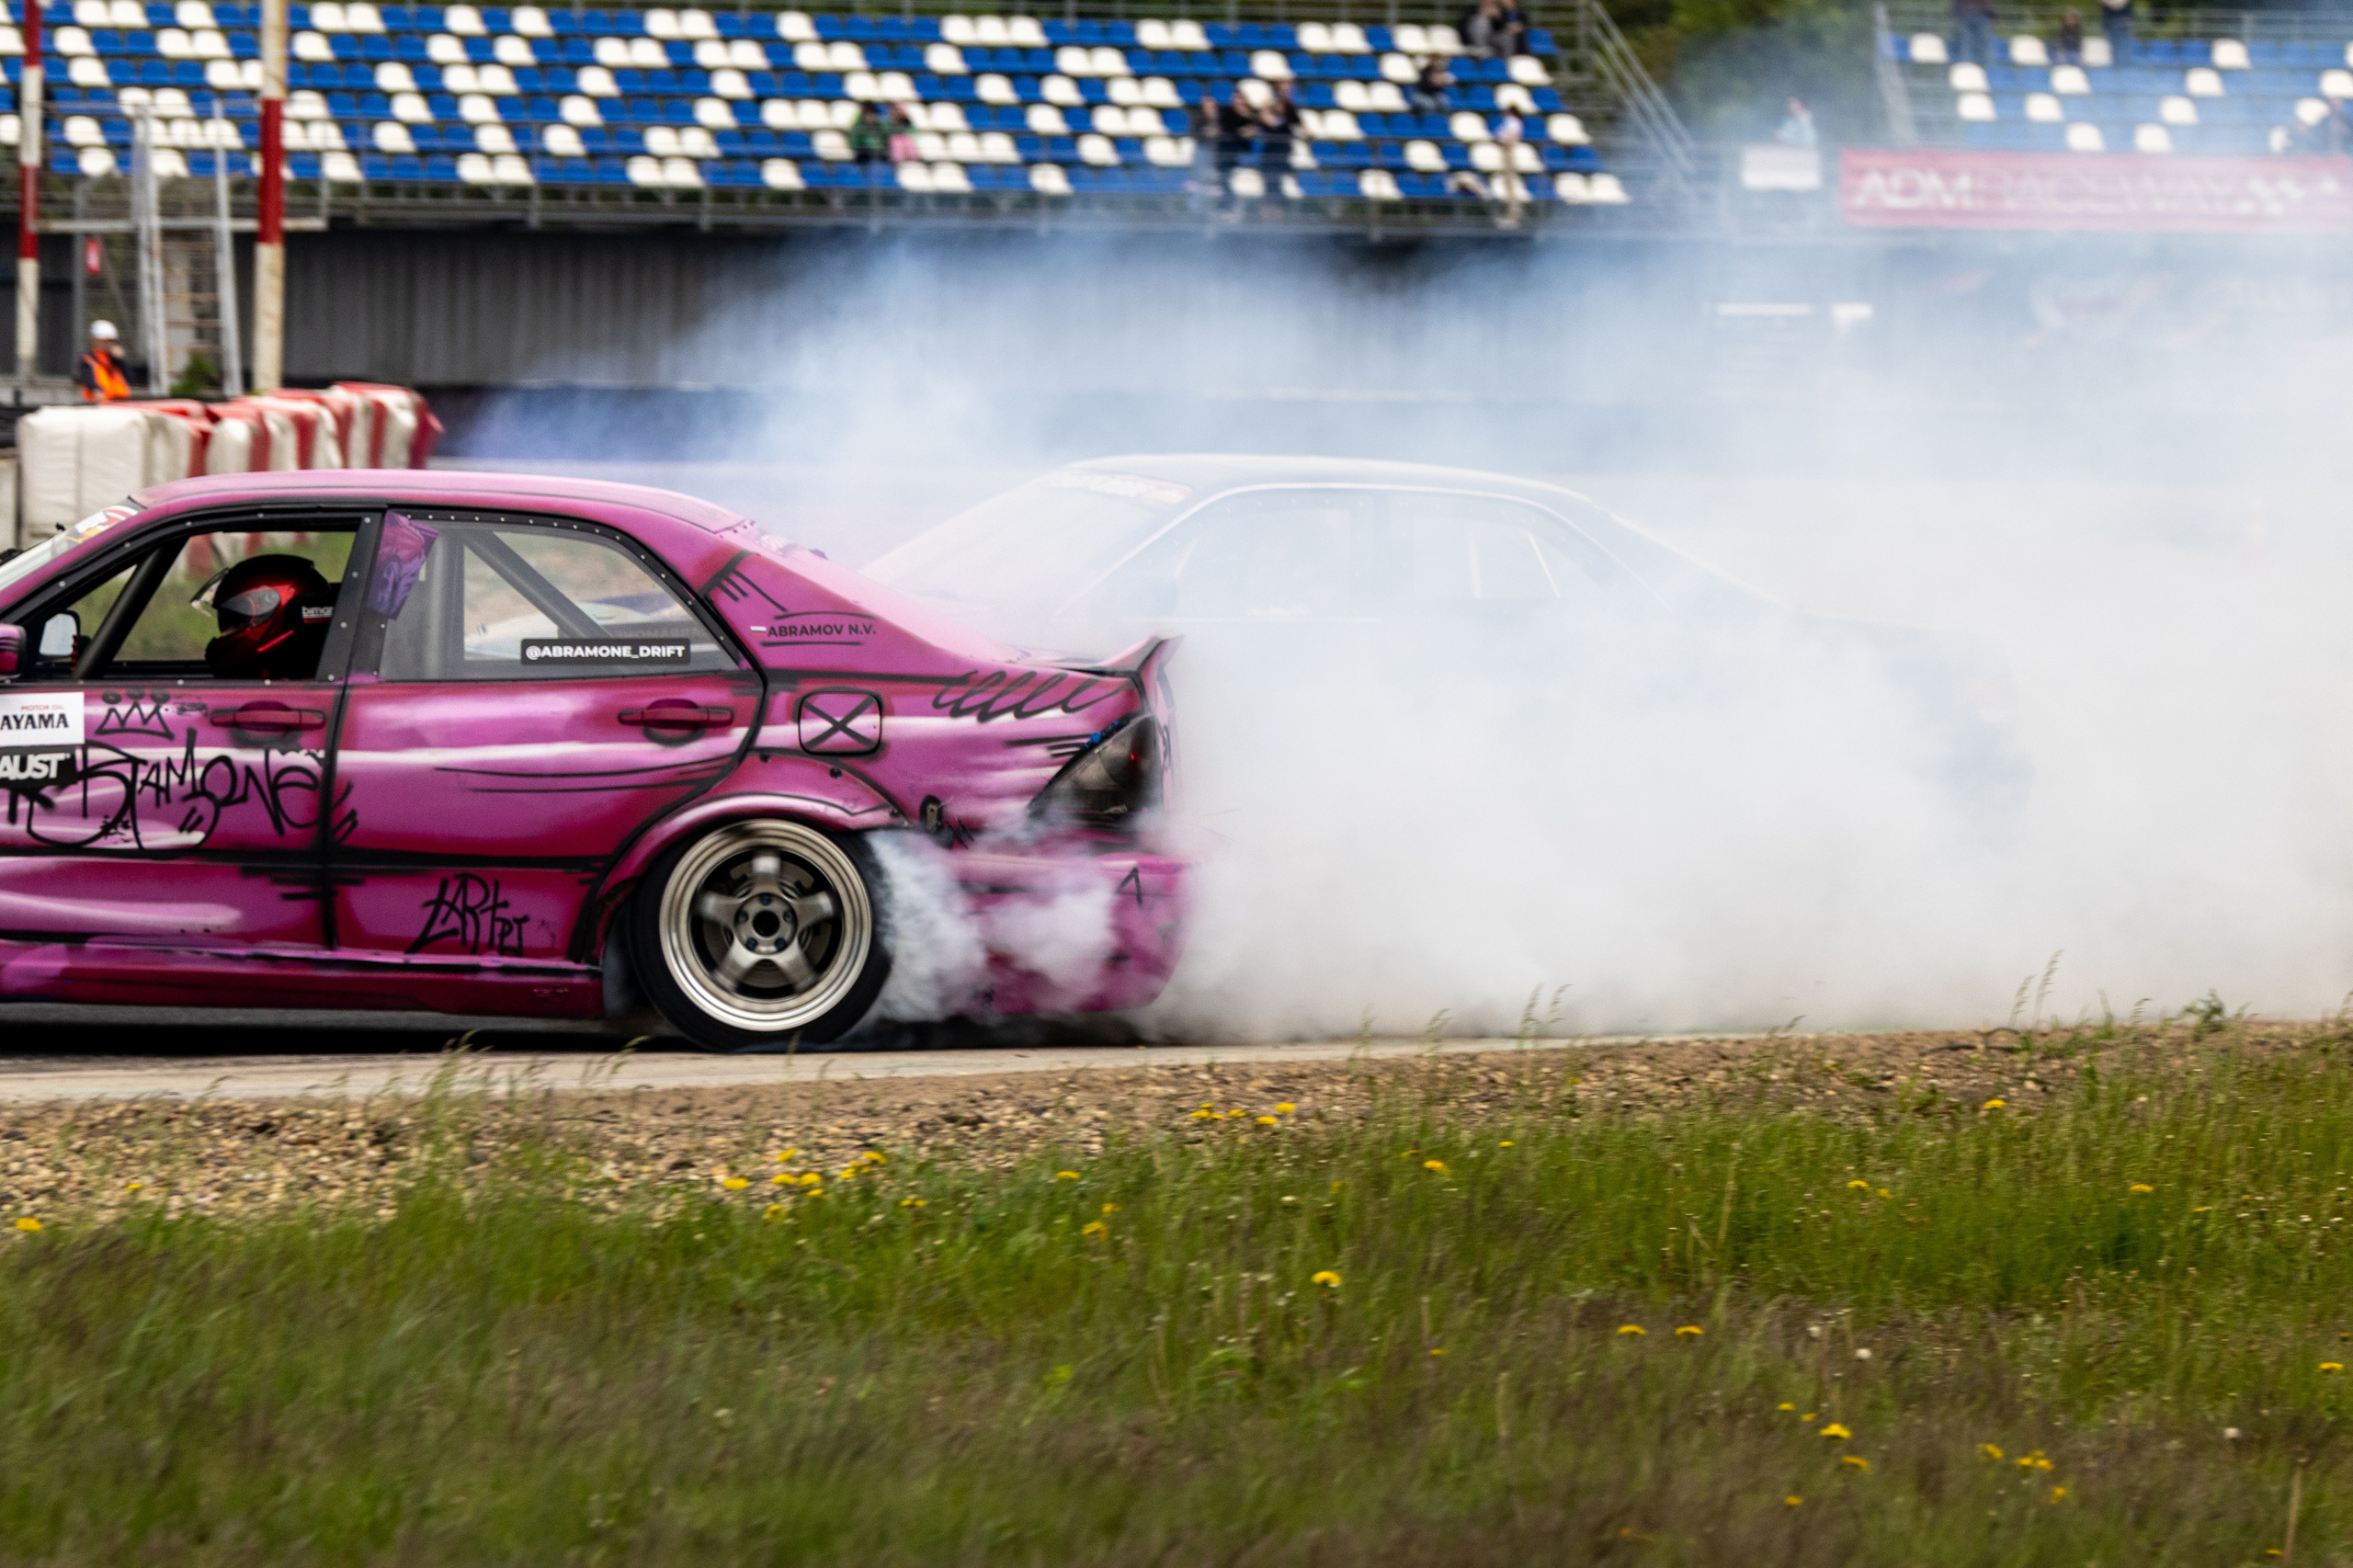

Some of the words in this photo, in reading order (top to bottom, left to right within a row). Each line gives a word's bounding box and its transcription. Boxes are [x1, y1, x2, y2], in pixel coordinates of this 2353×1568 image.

[1854, 168, 1972, 210] ADM
[767, 624, 845, 637] ABRAMOV
[848, 624, 877, 635] N.V.
[526, 645, 686, 661] @ABRAMONE_DRIFT
[0, 713, 69, 730] AYAMA
